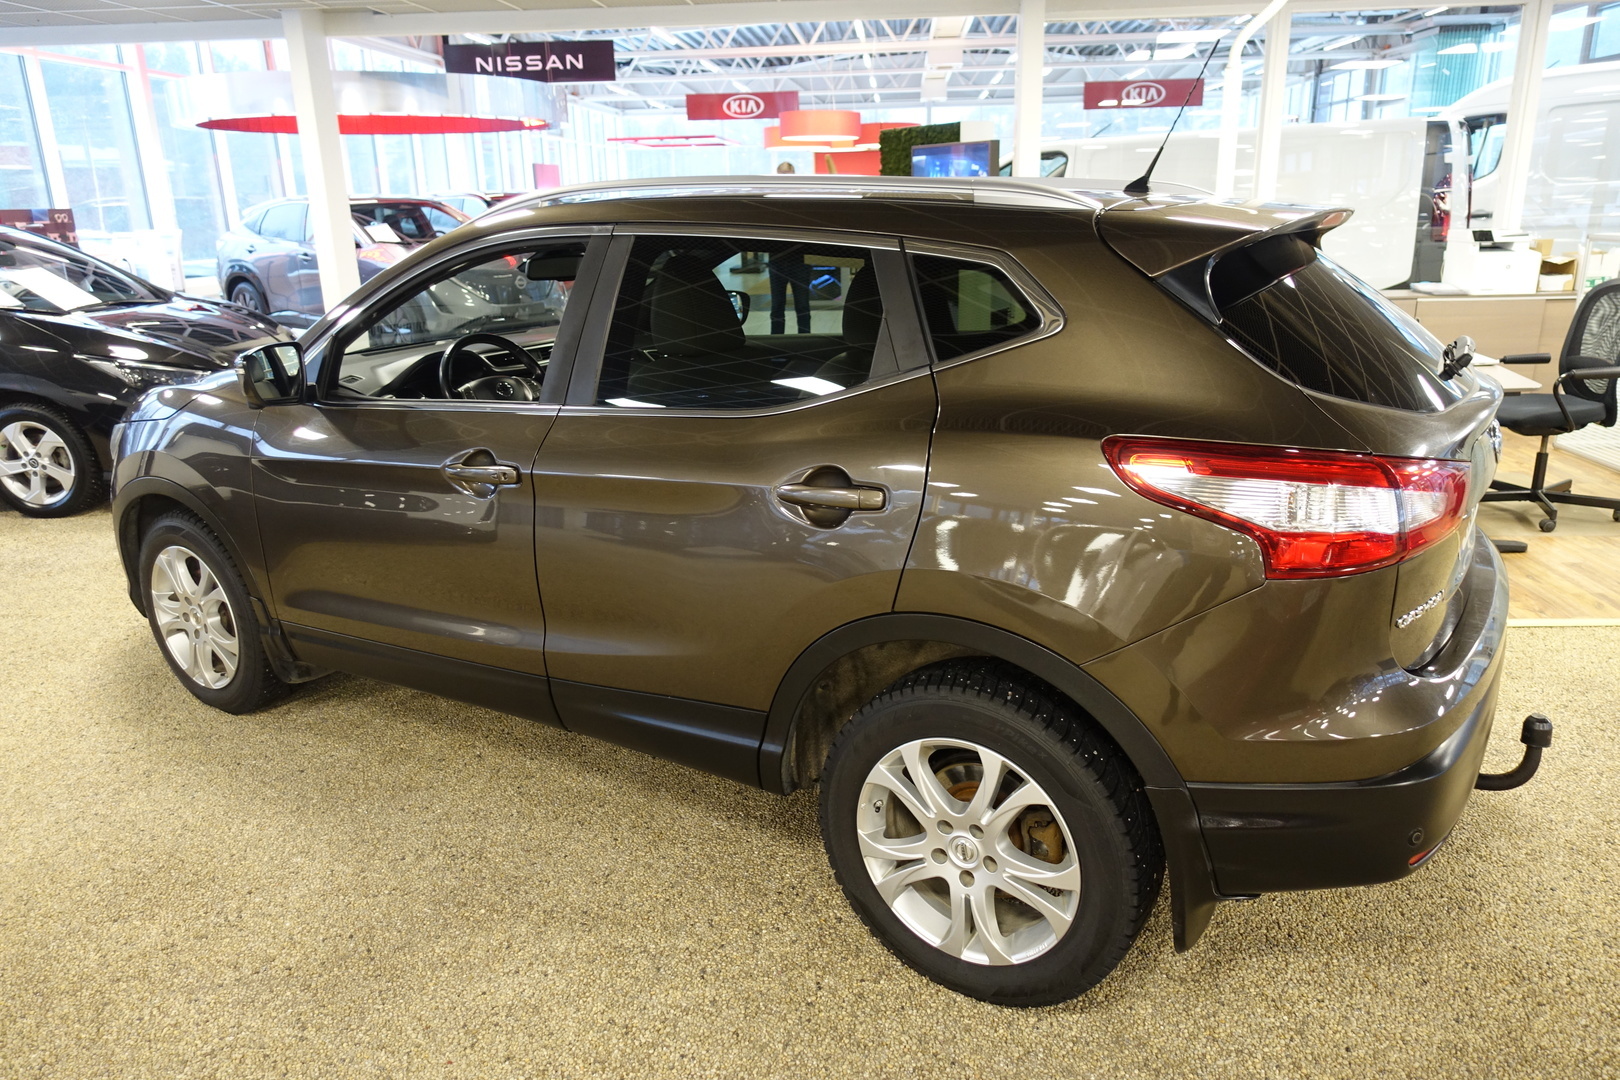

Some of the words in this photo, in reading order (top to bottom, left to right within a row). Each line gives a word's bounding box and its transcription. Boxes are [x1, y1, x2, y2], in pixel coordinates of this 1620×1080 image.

[475, 53, 584, 73] NISSAN
[1129, 87, 1158, 101] KIA
[730, 99, 758, 114] KIA
